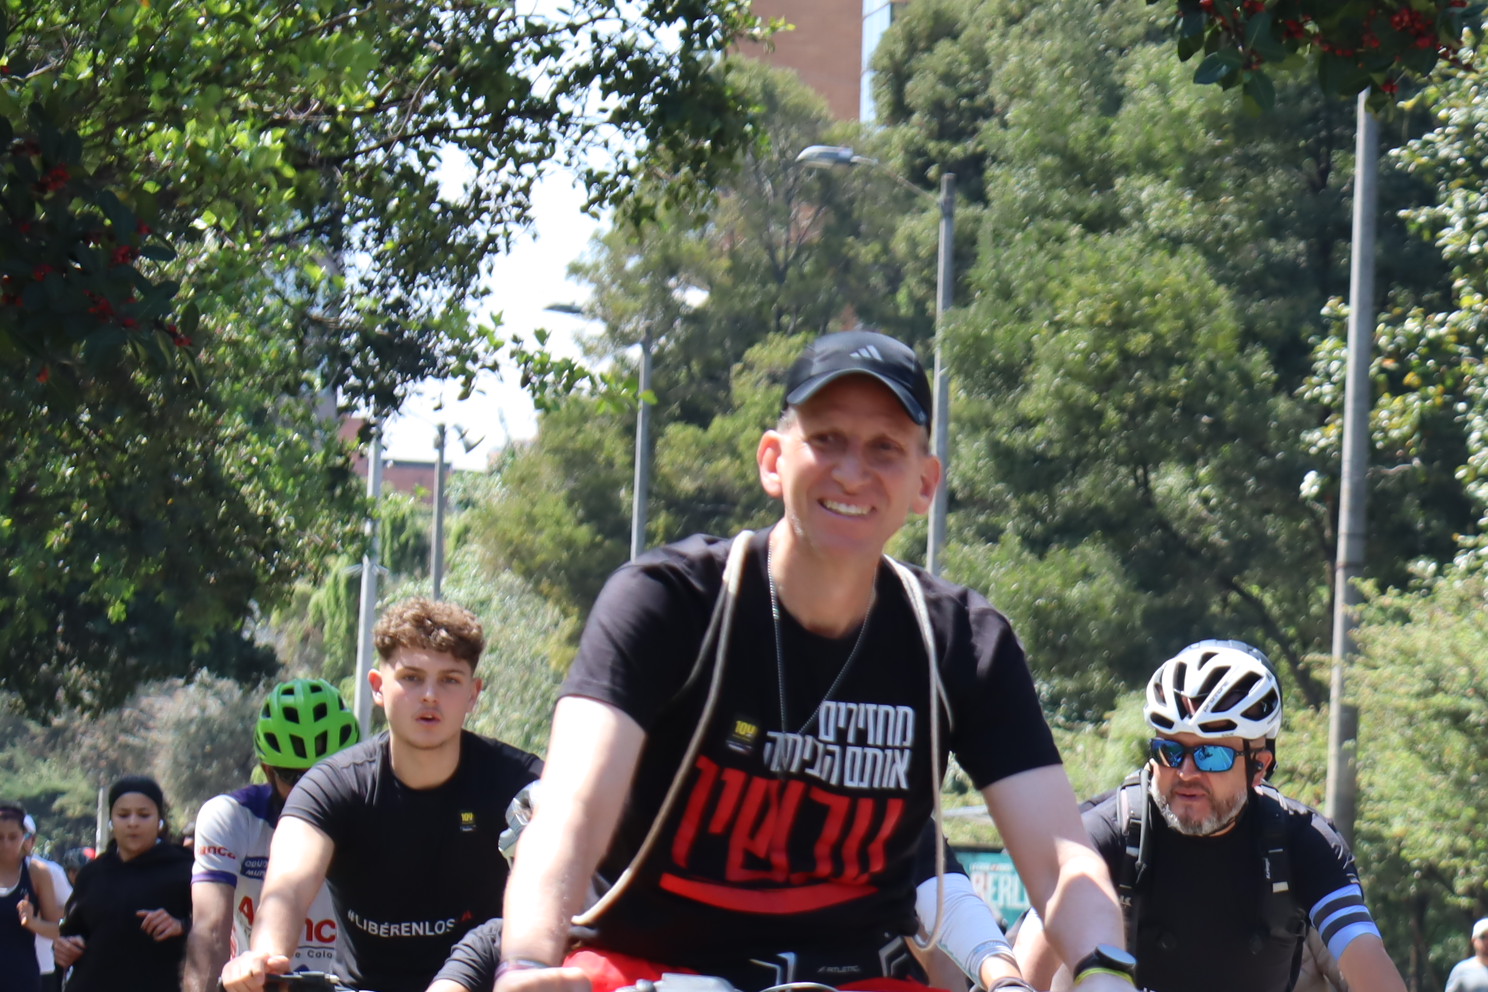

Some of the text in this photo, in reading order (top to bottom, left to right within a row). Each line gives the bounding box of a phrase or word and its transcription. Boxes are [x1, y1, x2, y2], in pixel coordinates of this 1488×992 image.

[818, 700, 916, 748] מחזירים
[844, 745, 911, 790] אותם
[671, 754, 905, 886] עכשיו
